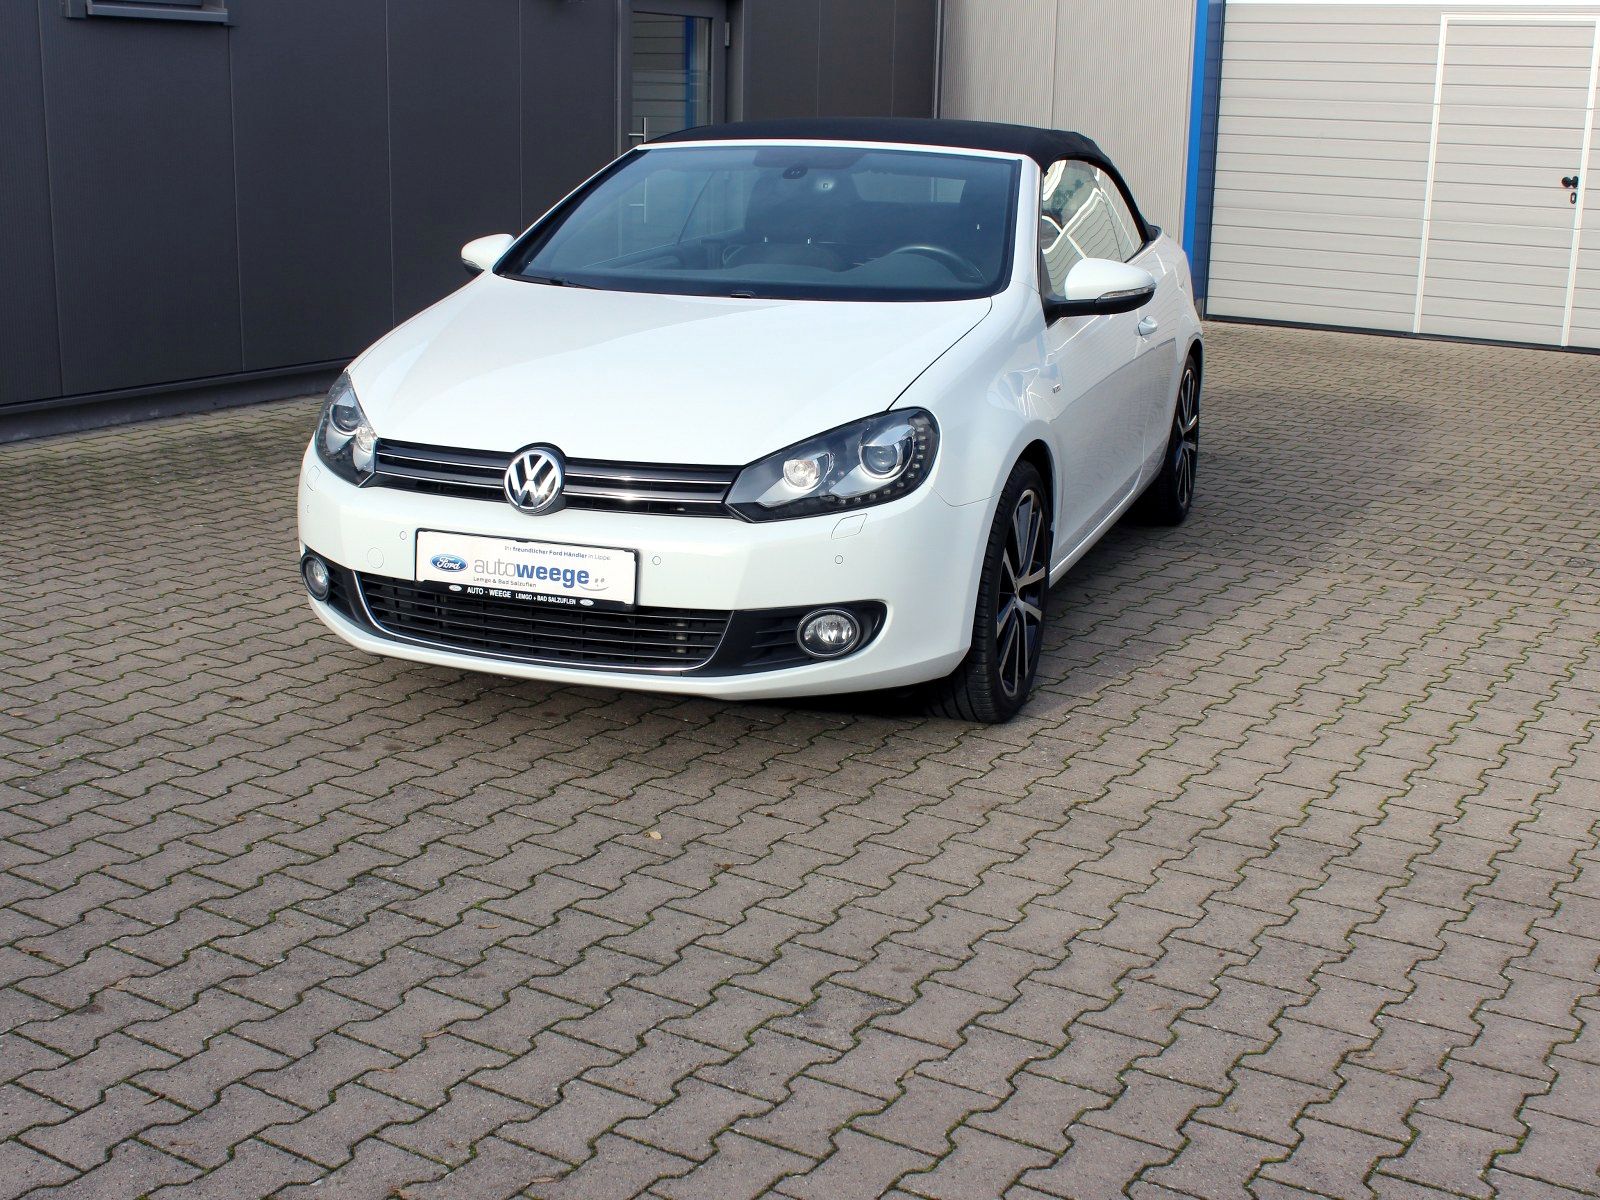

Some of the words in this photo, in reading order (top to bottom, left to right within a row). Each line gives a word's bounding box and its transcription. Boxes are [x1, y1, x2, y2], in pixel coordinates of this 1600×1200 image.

[513, 546, 548, 555] freundlicher
[549, 549, 562, 557] Ford
[564, 551, 588, 559] Händler
[436, 557, 461, 570] Ford
[474, 557, 590, 588] autoweege
[473, 576, 492, 584] Lemgo
[510, 580, 537, 588] Salzuflen
[467, 587, 484, 595] AUTO
[489, 589, 512, 598] WEEGE
[515, 592, 533, 600] LEMGO
[548, 596, 576, 605] SALZUFLEN
